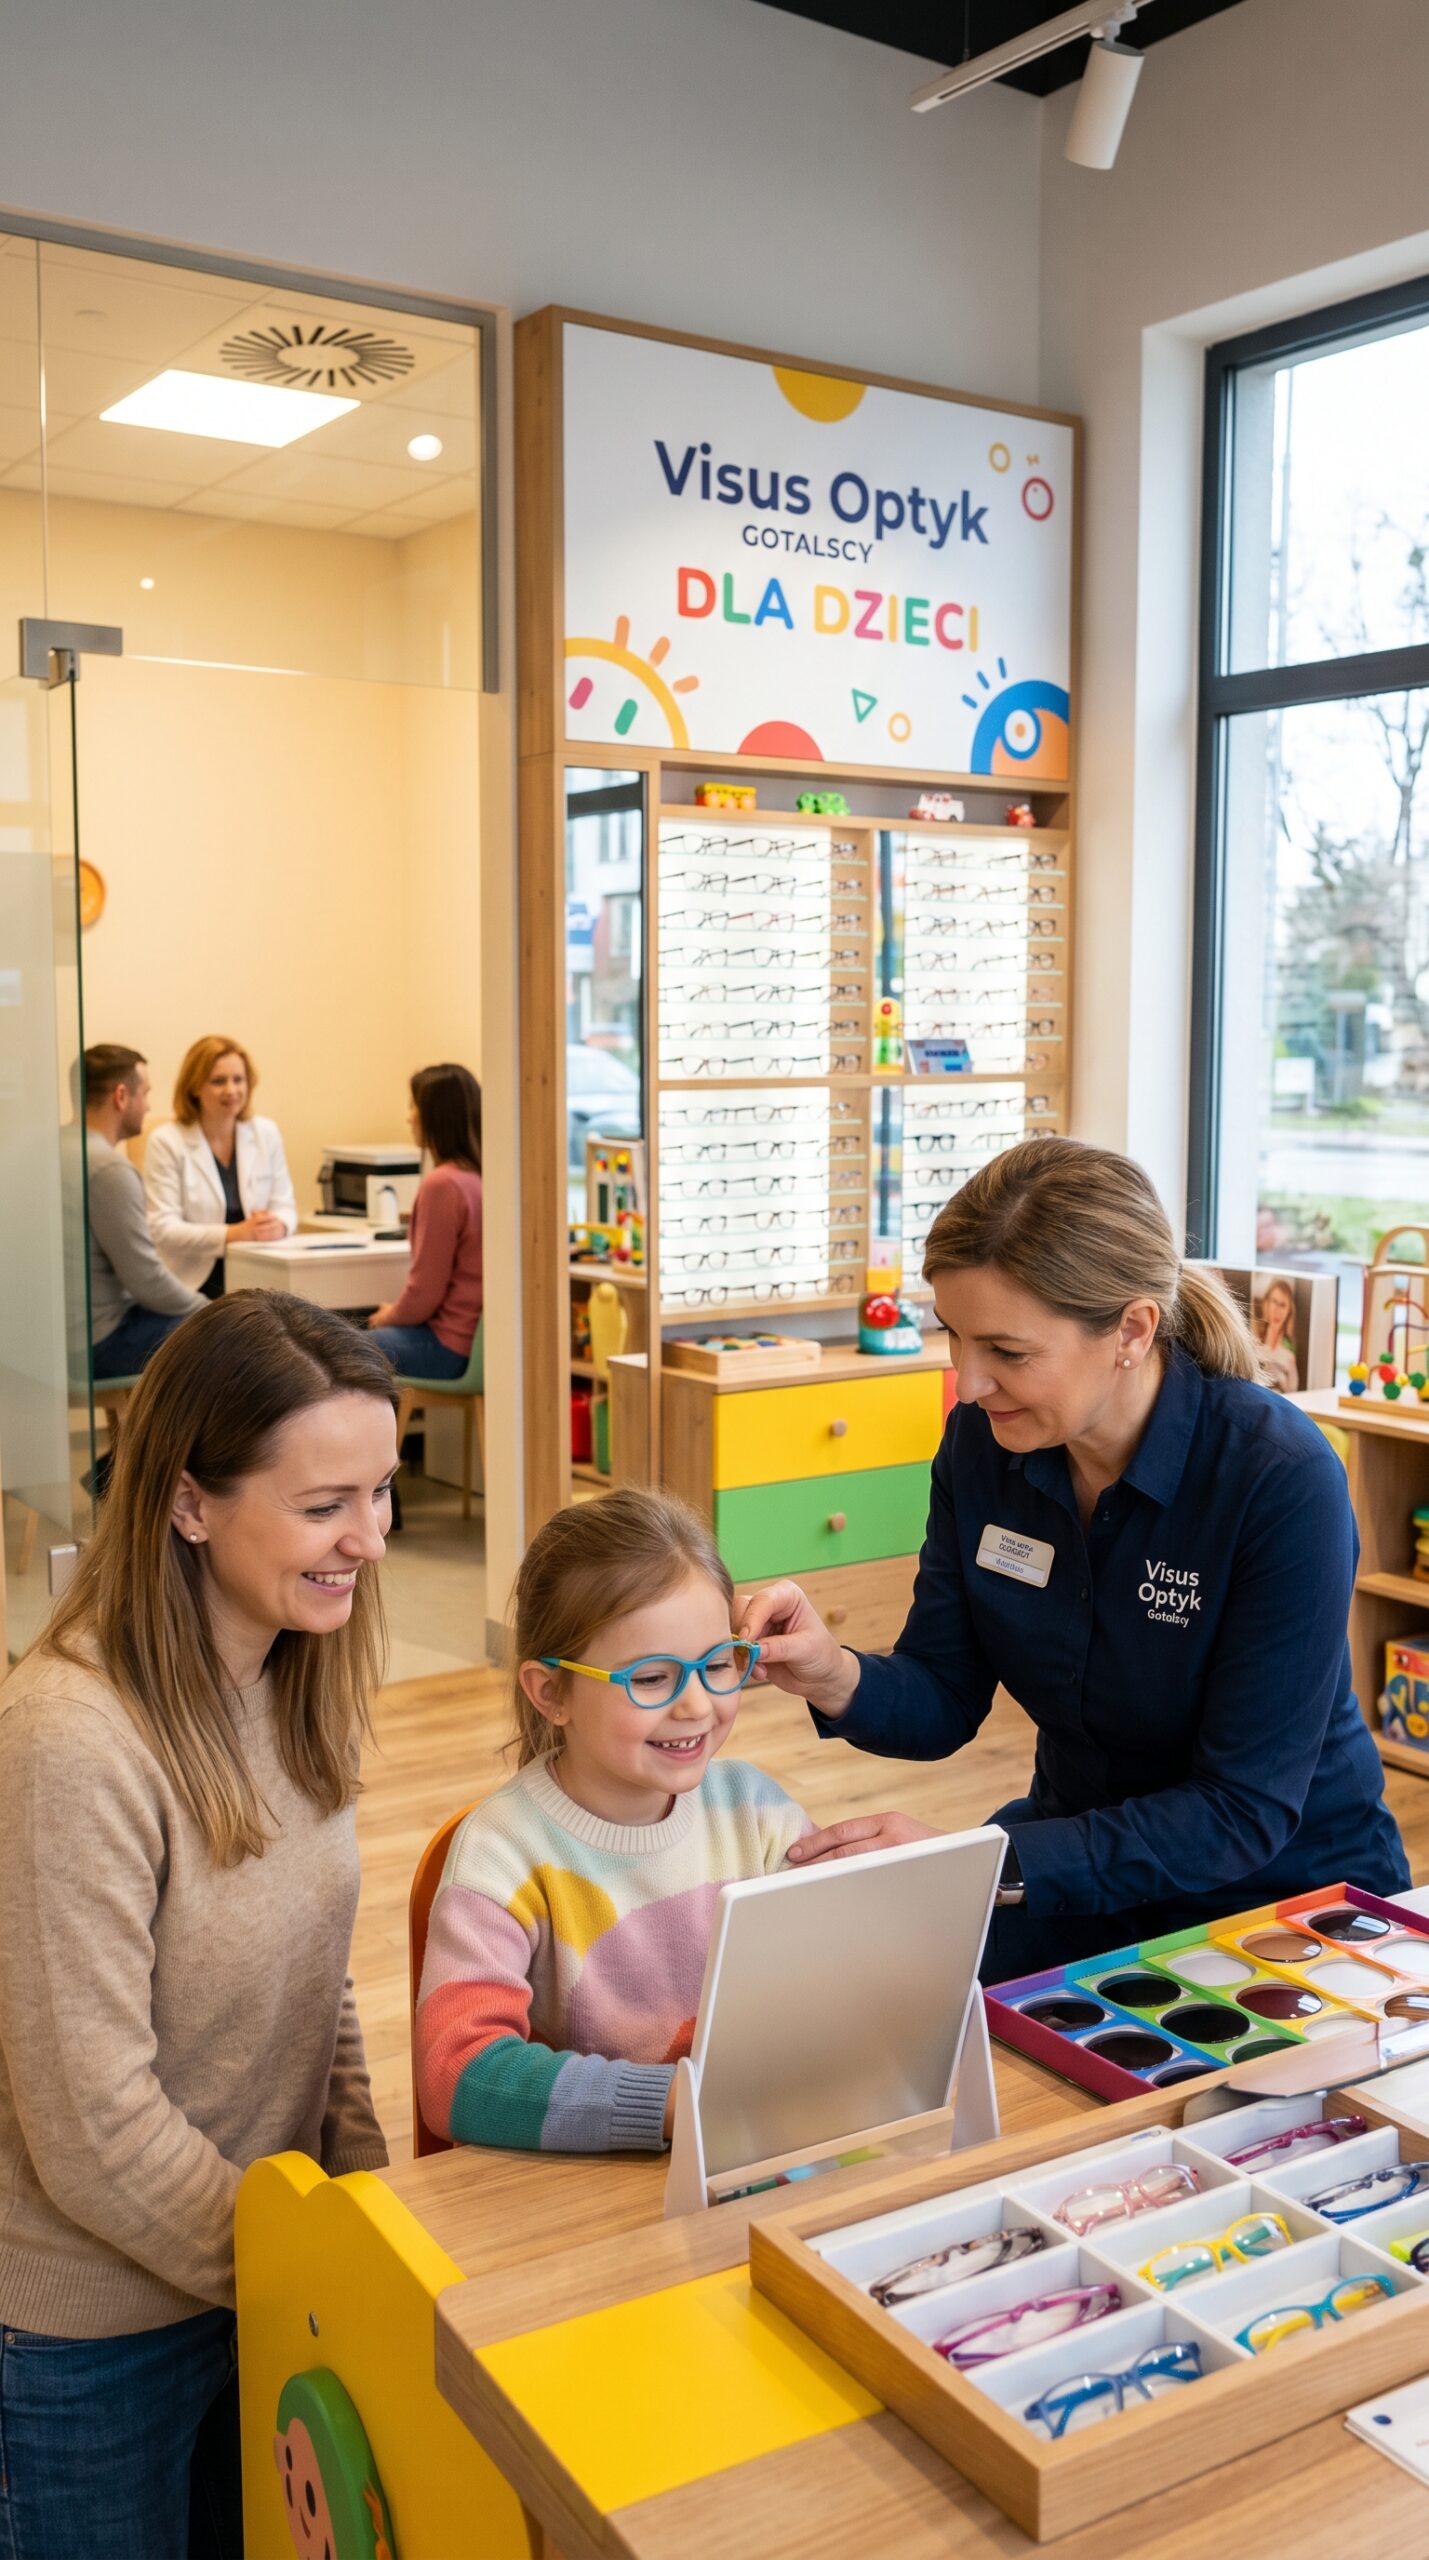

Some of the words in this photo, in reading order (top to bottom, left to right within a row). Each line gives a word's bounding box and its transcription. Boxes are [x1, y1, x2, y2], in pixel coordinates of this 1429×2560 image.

[654, 439, 811, 515] Visus
[829, 471, 990, 551] Optyk
[741, 524, 873, 564] GOTALSCY
[676, 565, 795, 630] DLA
[813, 584, 979, 652] DZIECI
[1145, 1559, 1200, 1587] Visus
[1138, 1582, 1202, 1613] Optyk
